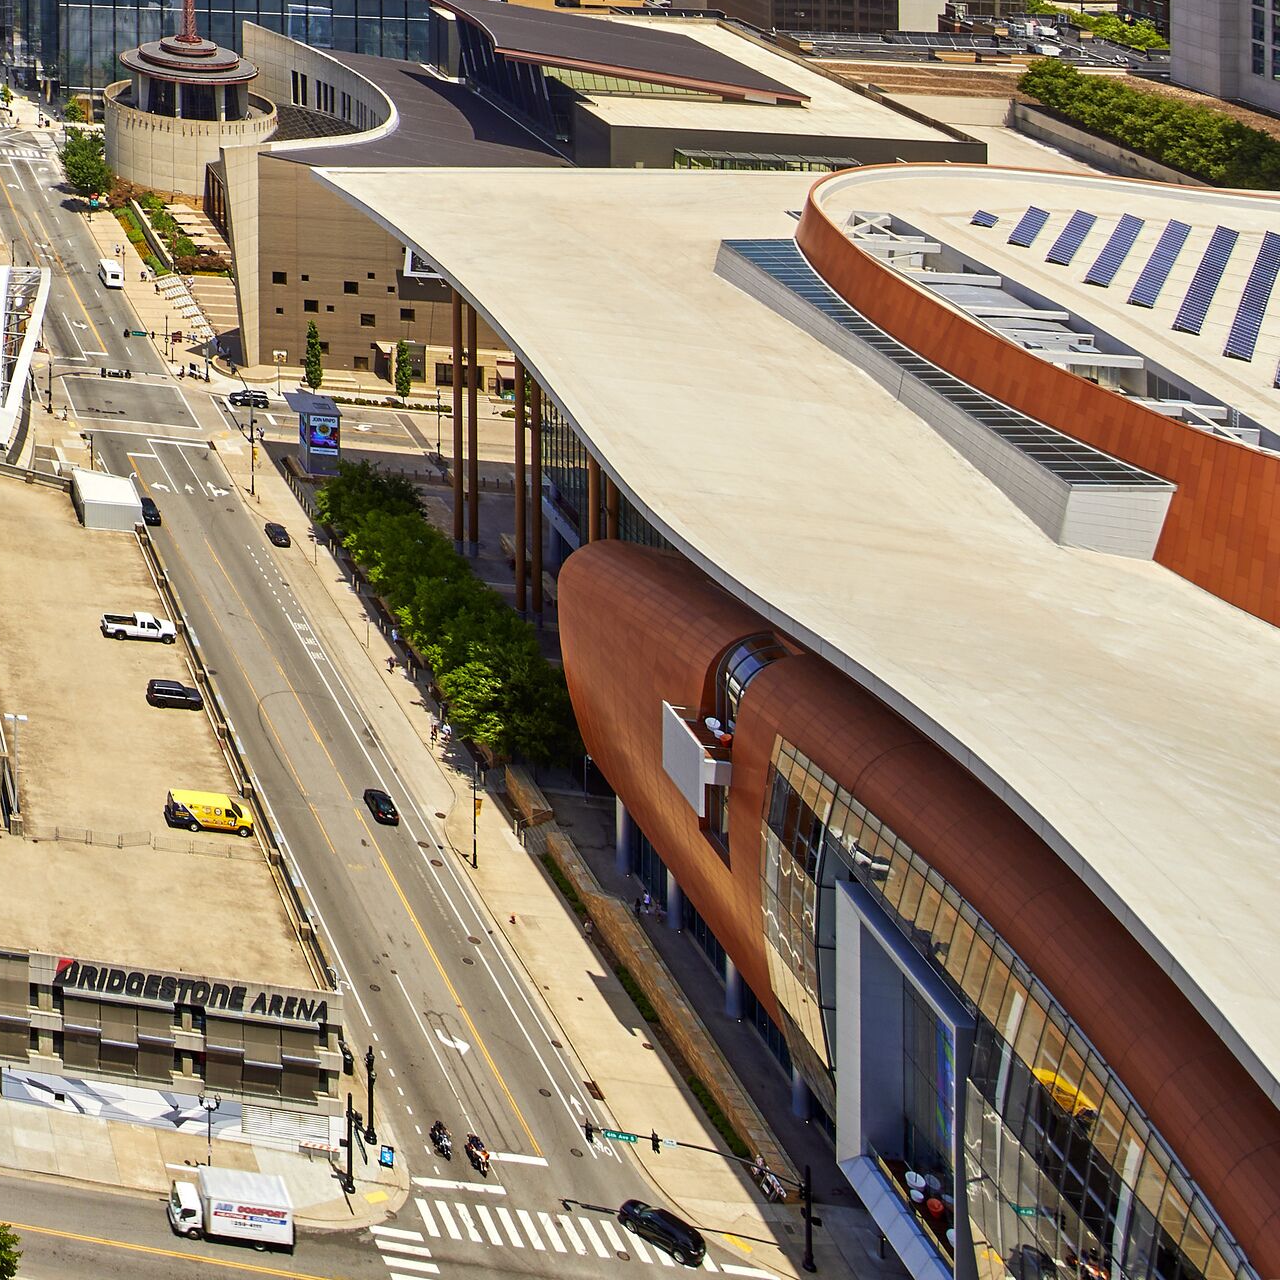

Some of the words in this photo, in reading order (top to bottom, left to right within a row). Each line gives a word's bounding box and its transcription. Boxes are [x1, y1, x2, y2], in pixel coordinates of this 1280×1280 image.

[53, 959, 247, 1010] BRIDGESTONE
[251, 992, 328, 1024] ARENA
[237, 1205, 288, 1219] COMFORT
